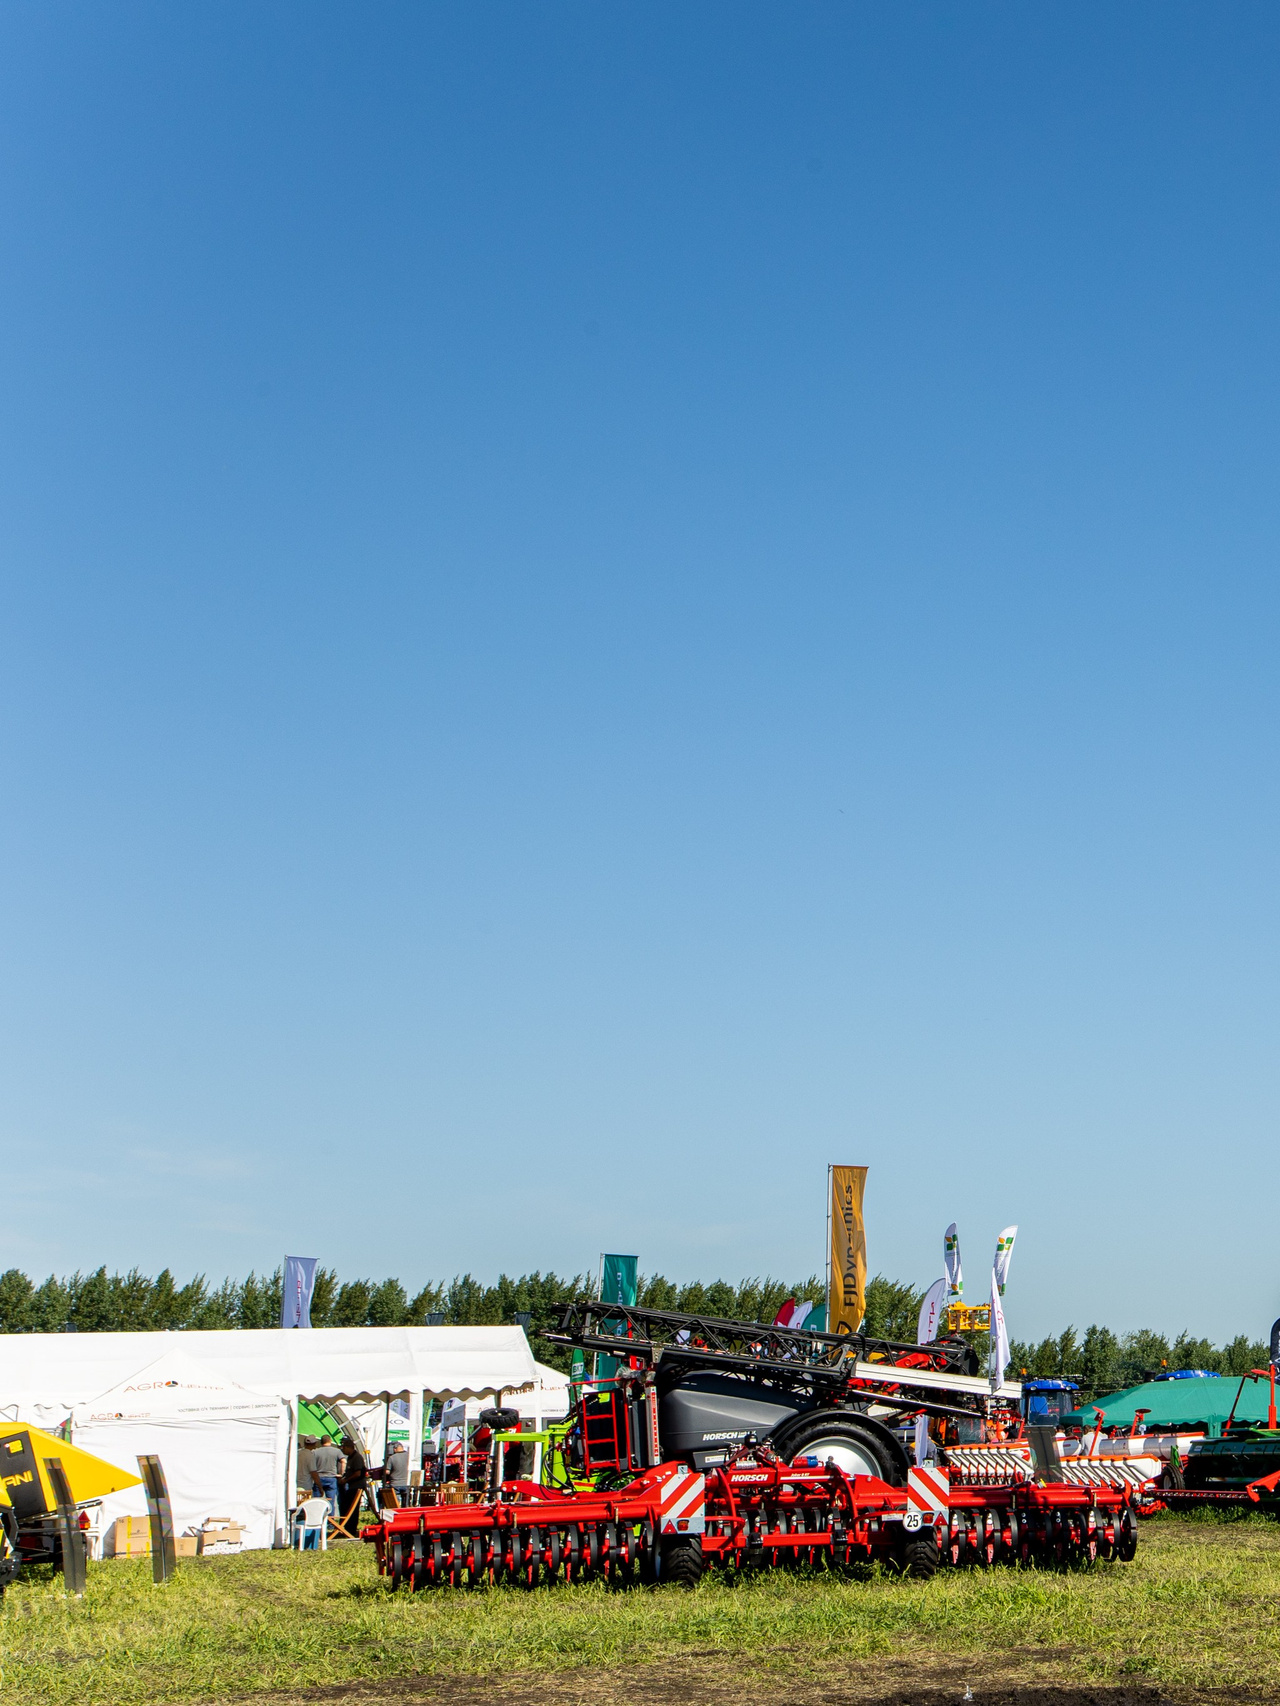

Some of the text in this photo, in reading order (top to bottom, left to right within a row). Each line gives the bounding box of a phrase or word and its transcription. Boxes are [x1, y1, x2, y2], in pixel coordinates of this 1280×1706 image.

[702, 1431, 738, 1441] HORSCH
[731, 1474, 769, 1482] HORSCH
[906, 1514, 919, 1528] 25
